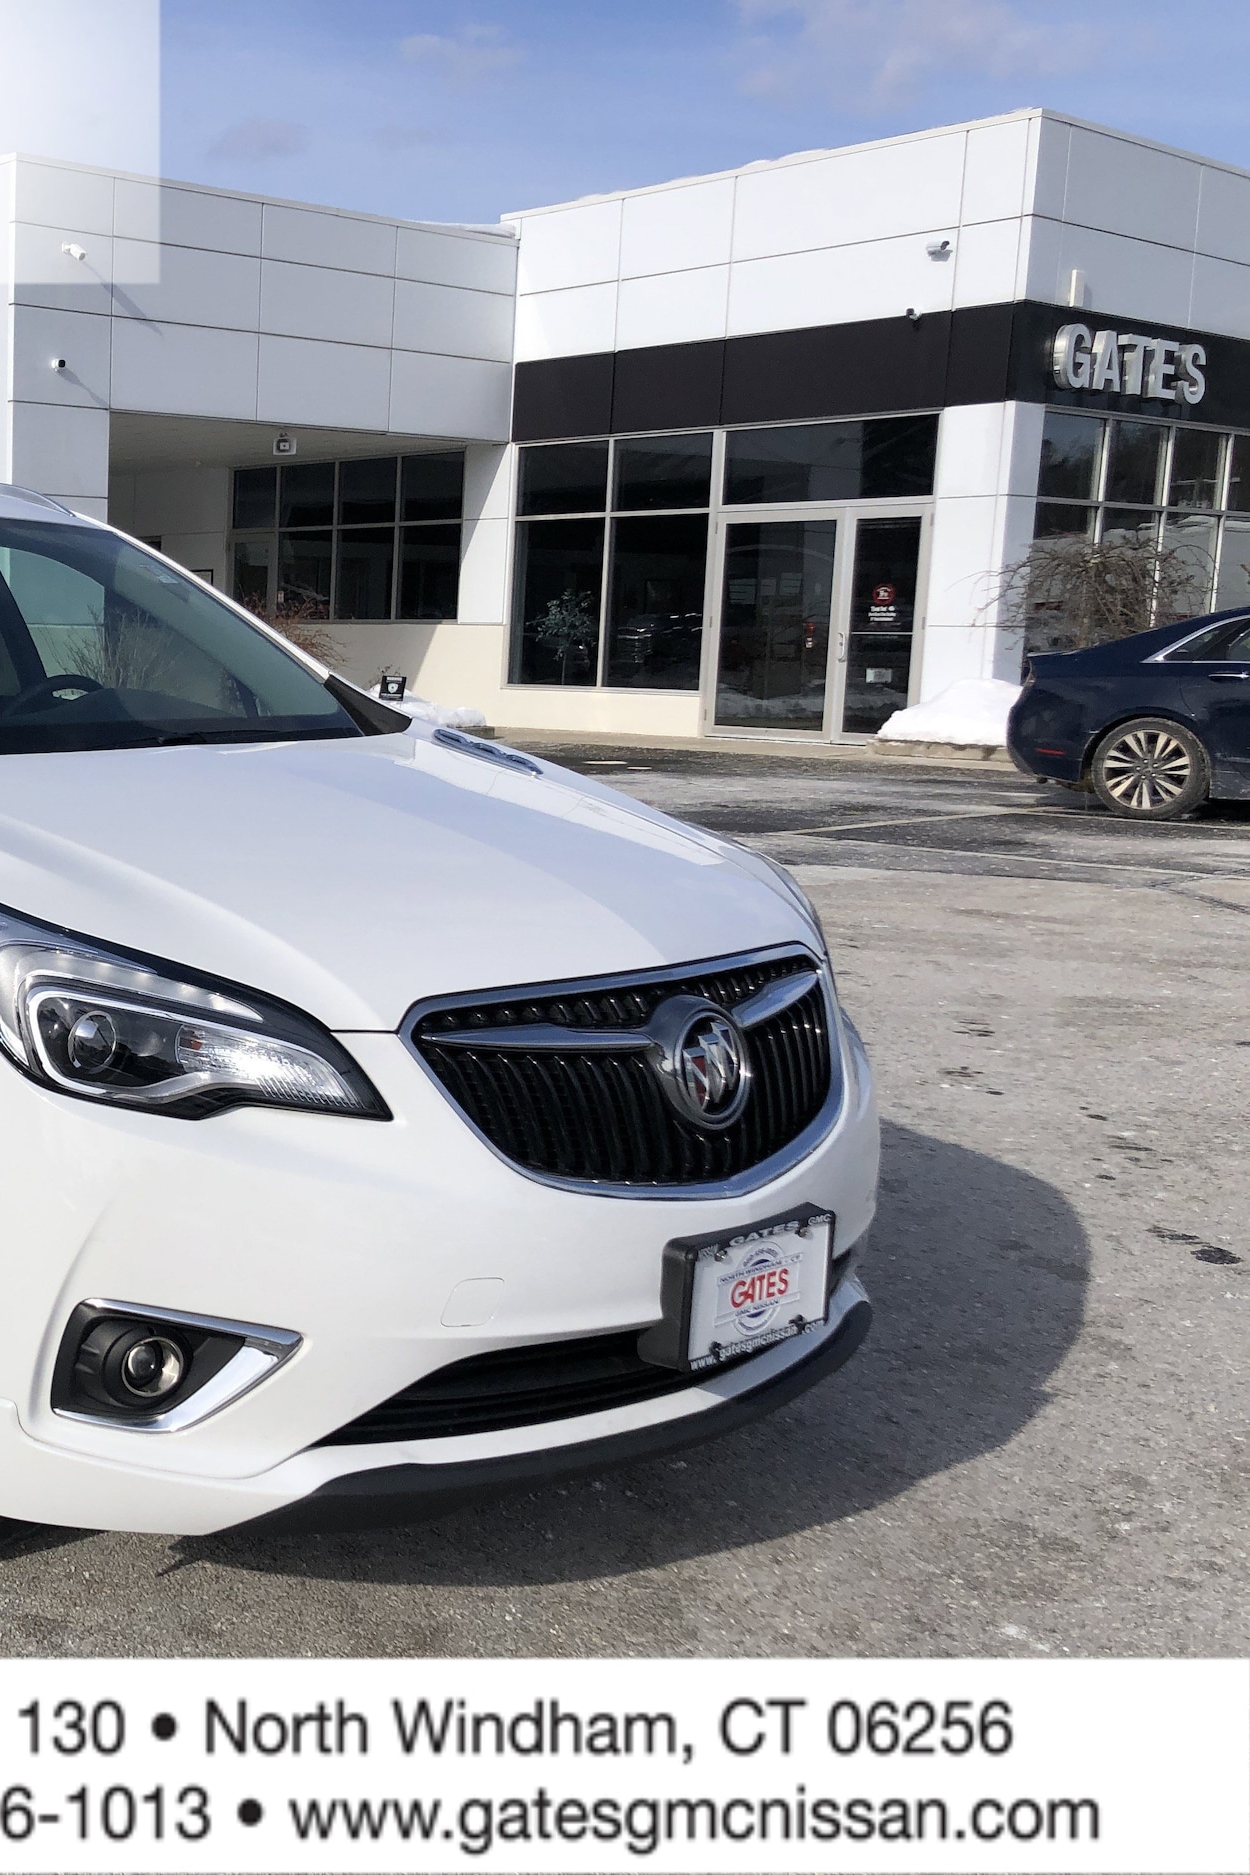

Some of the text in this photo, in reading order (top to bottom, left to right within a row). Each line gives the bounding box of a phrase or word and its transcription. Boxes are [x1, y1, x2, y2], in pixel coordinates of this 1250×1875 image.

[1054, 323, 1207, 404] GATES
[729, 1220, 800, 1247] GATES
[807, 1213, 832, 1226] GMC
[730, 1267, 790, 1309] GATES
